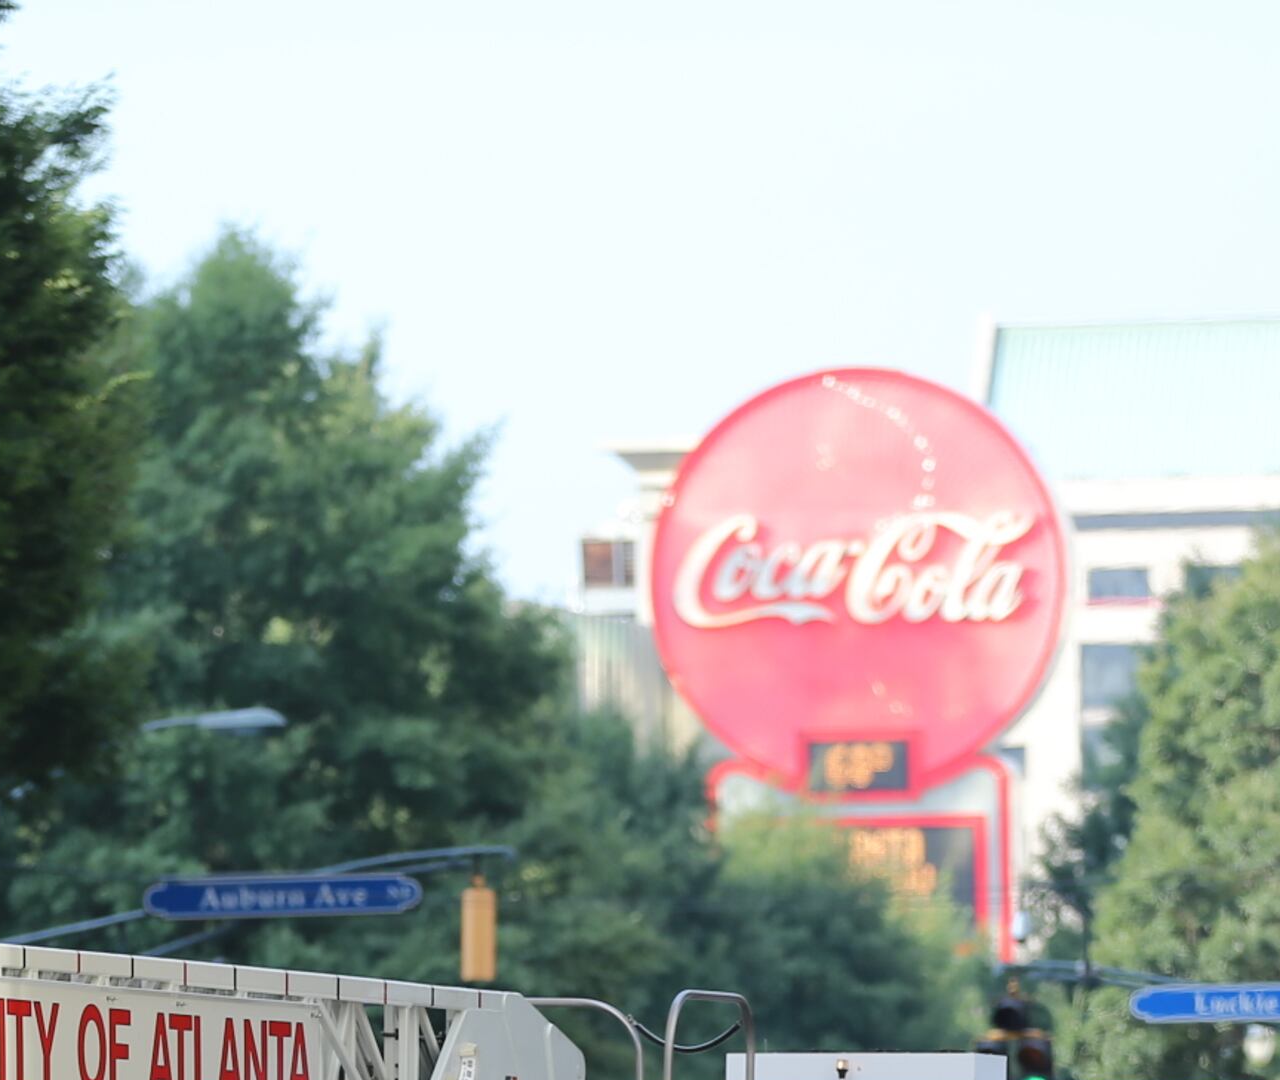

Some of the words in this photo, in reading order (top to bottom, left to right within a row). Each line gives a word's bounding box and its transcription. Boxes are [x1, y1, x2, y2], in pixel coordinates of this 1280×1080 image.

[674, 511, 1035, 629] Coca-Cola
[199, 886, 305, 911] Auburn
[314, 882, 368, 907] Ave
[1195, 991, 1278, 1015] Luckie
